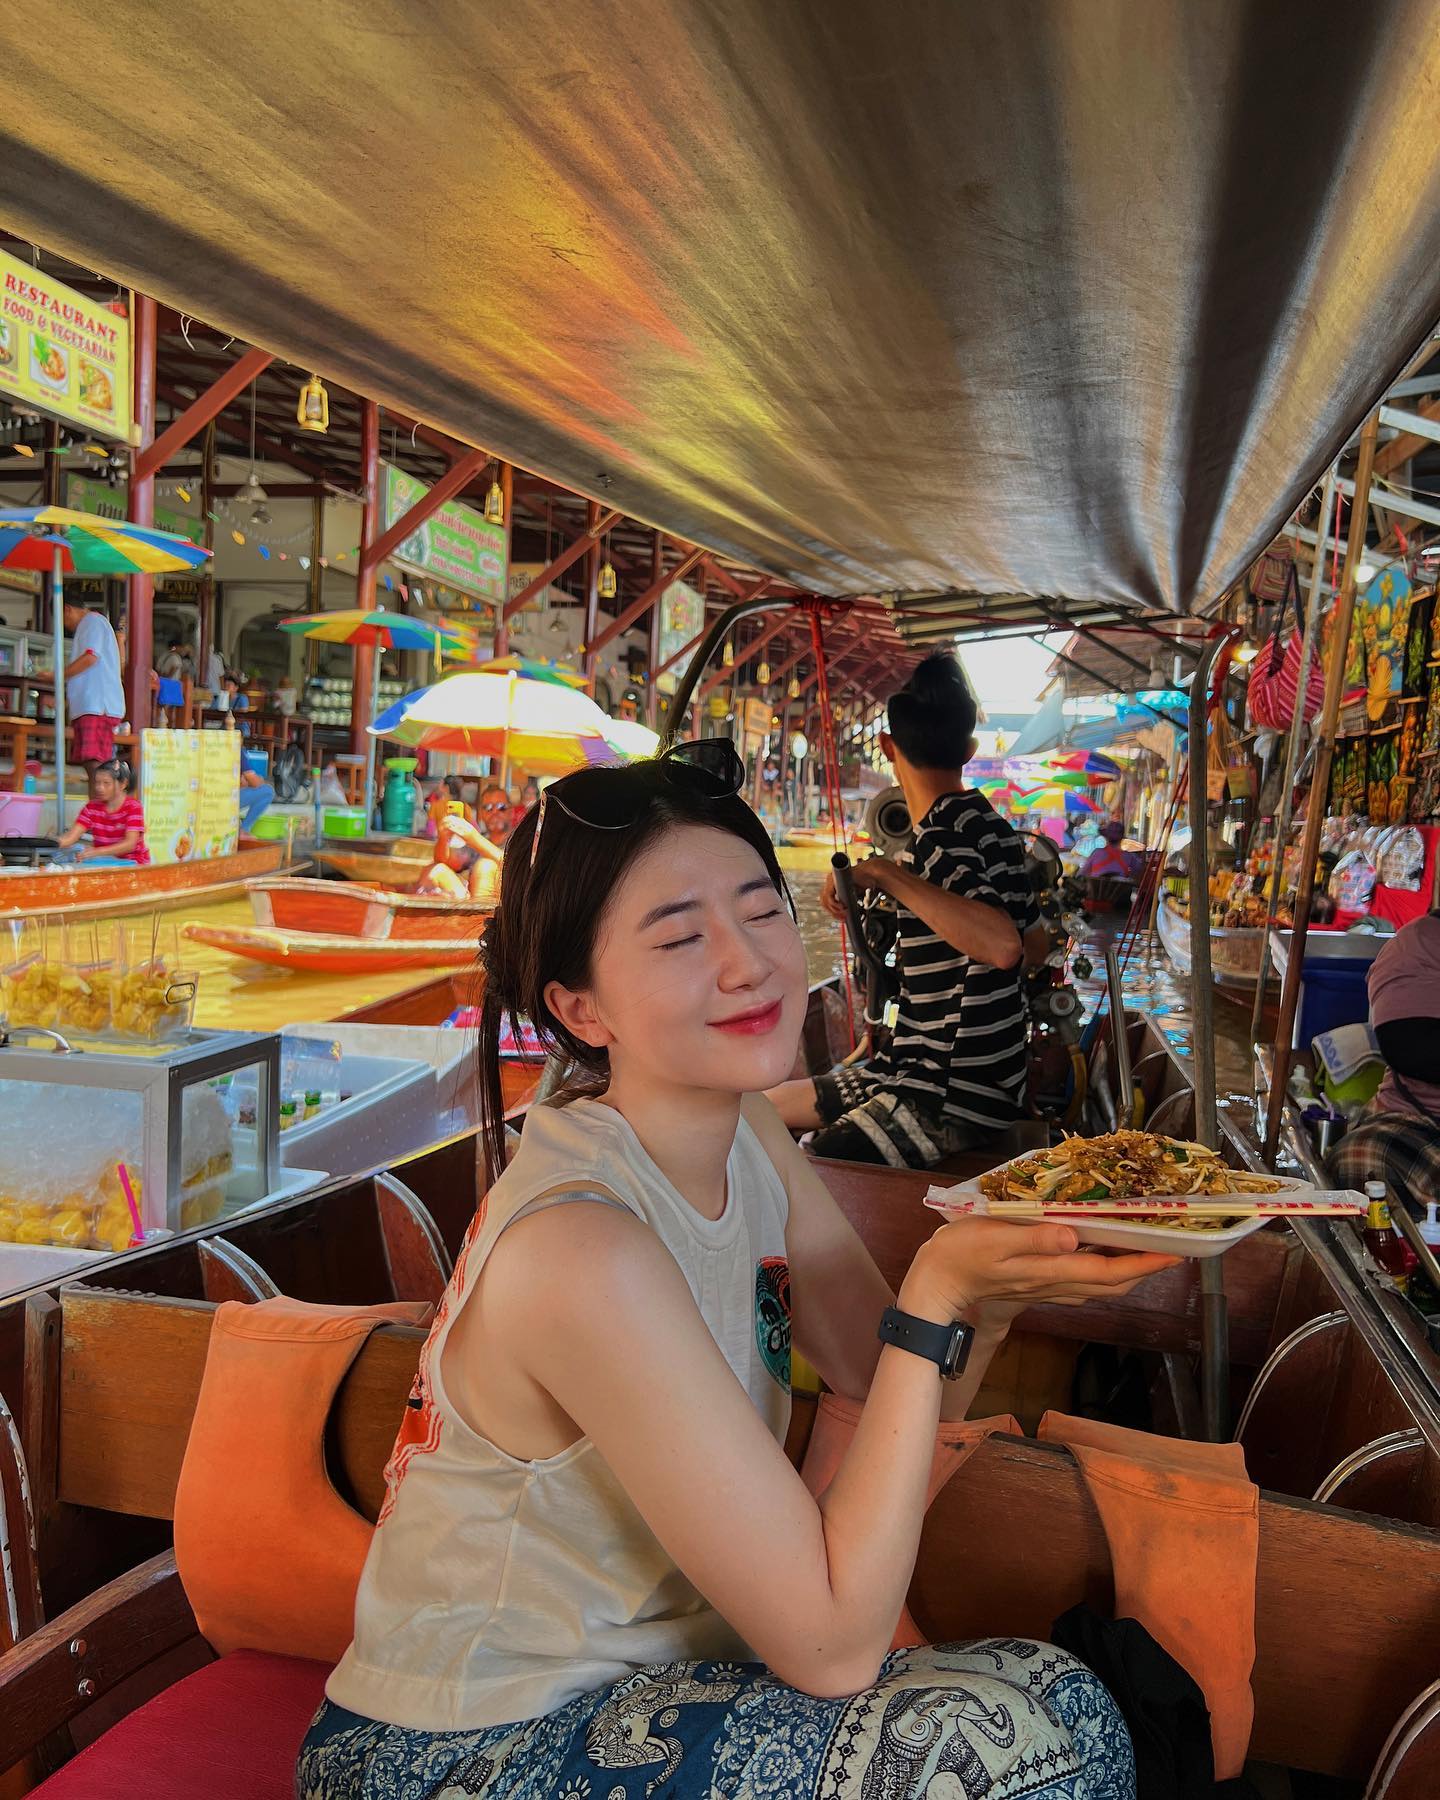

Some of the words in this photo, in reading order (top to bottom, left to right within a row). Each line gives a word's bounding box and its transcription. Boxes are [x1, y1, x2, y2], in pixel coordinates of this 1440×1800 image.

[4, 298, 34, 322] FOOD
[38, 315, 47, 329] &
[51, 321, 115, 363] VEGETARIAN
[5, 273, 118, 343] RESTAURANT
